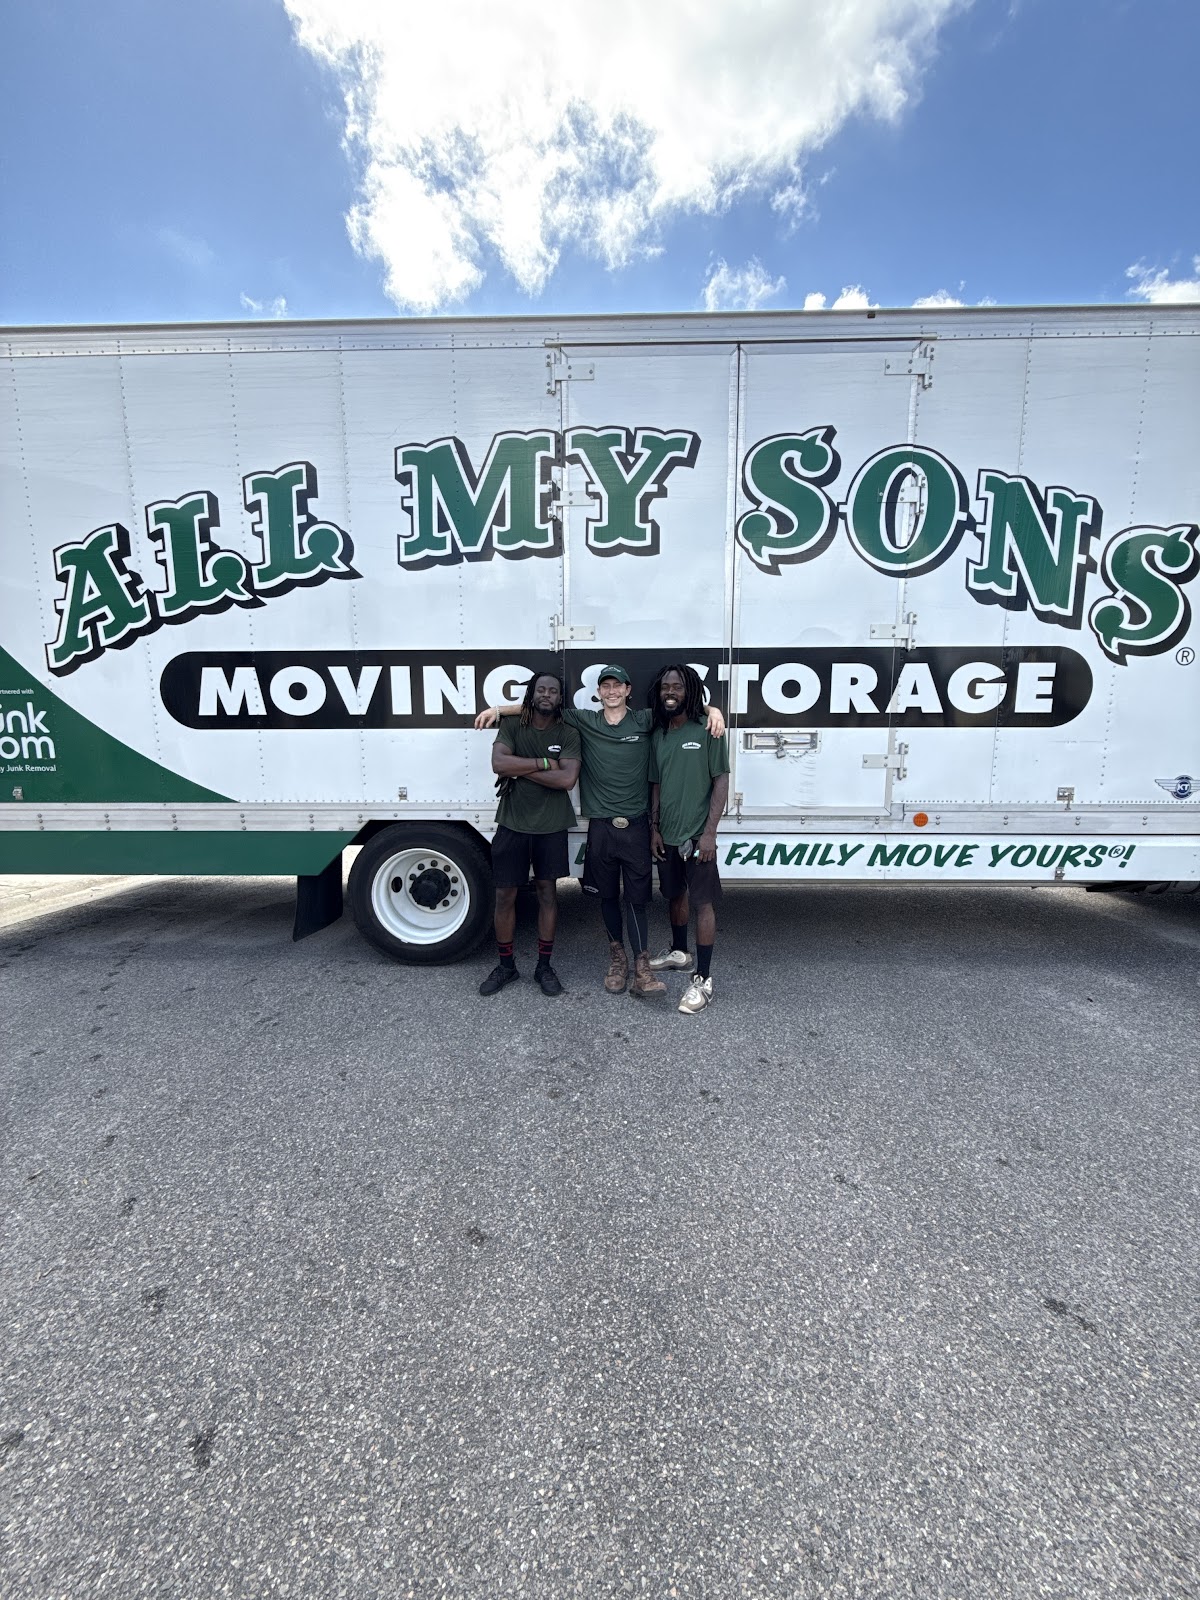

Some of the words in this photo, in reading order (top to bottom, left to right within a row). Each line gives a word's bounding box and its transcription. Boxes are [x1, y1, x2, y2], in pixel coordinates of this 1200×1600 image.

[44, 461, 362, 676] ALL
[395, 426, 700, 571] MY
[735, 425, 1200, 666] SONS
[198, 665, 535, 717] MOVING
[6, 764, 24, 772] Junk
[25, 764, 56, 772] Removal
[724, 842, 865, 867] FAMILY
[866, 843, 980, 867] MOVE
